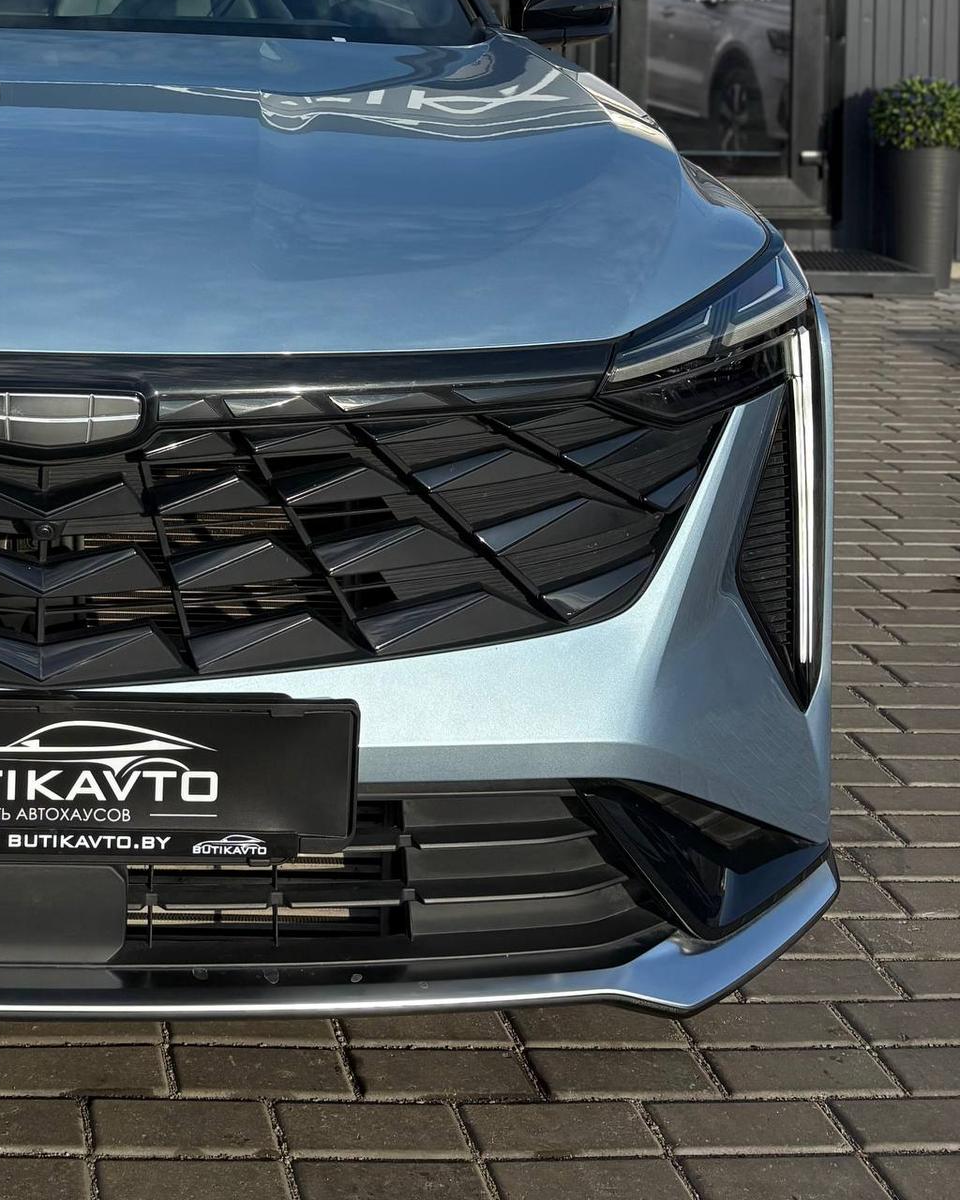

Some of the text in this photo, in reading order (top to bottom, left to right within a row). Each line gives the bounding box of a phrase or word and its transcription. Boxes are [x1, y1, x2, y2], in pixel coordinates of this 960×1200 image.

[15, 807, 131, 823] АВТОХАУСОВ
[8, 834, 172, 850] BUTIKAVTO.BY
[192, 845, 267, 856] BUTIKAVTO
